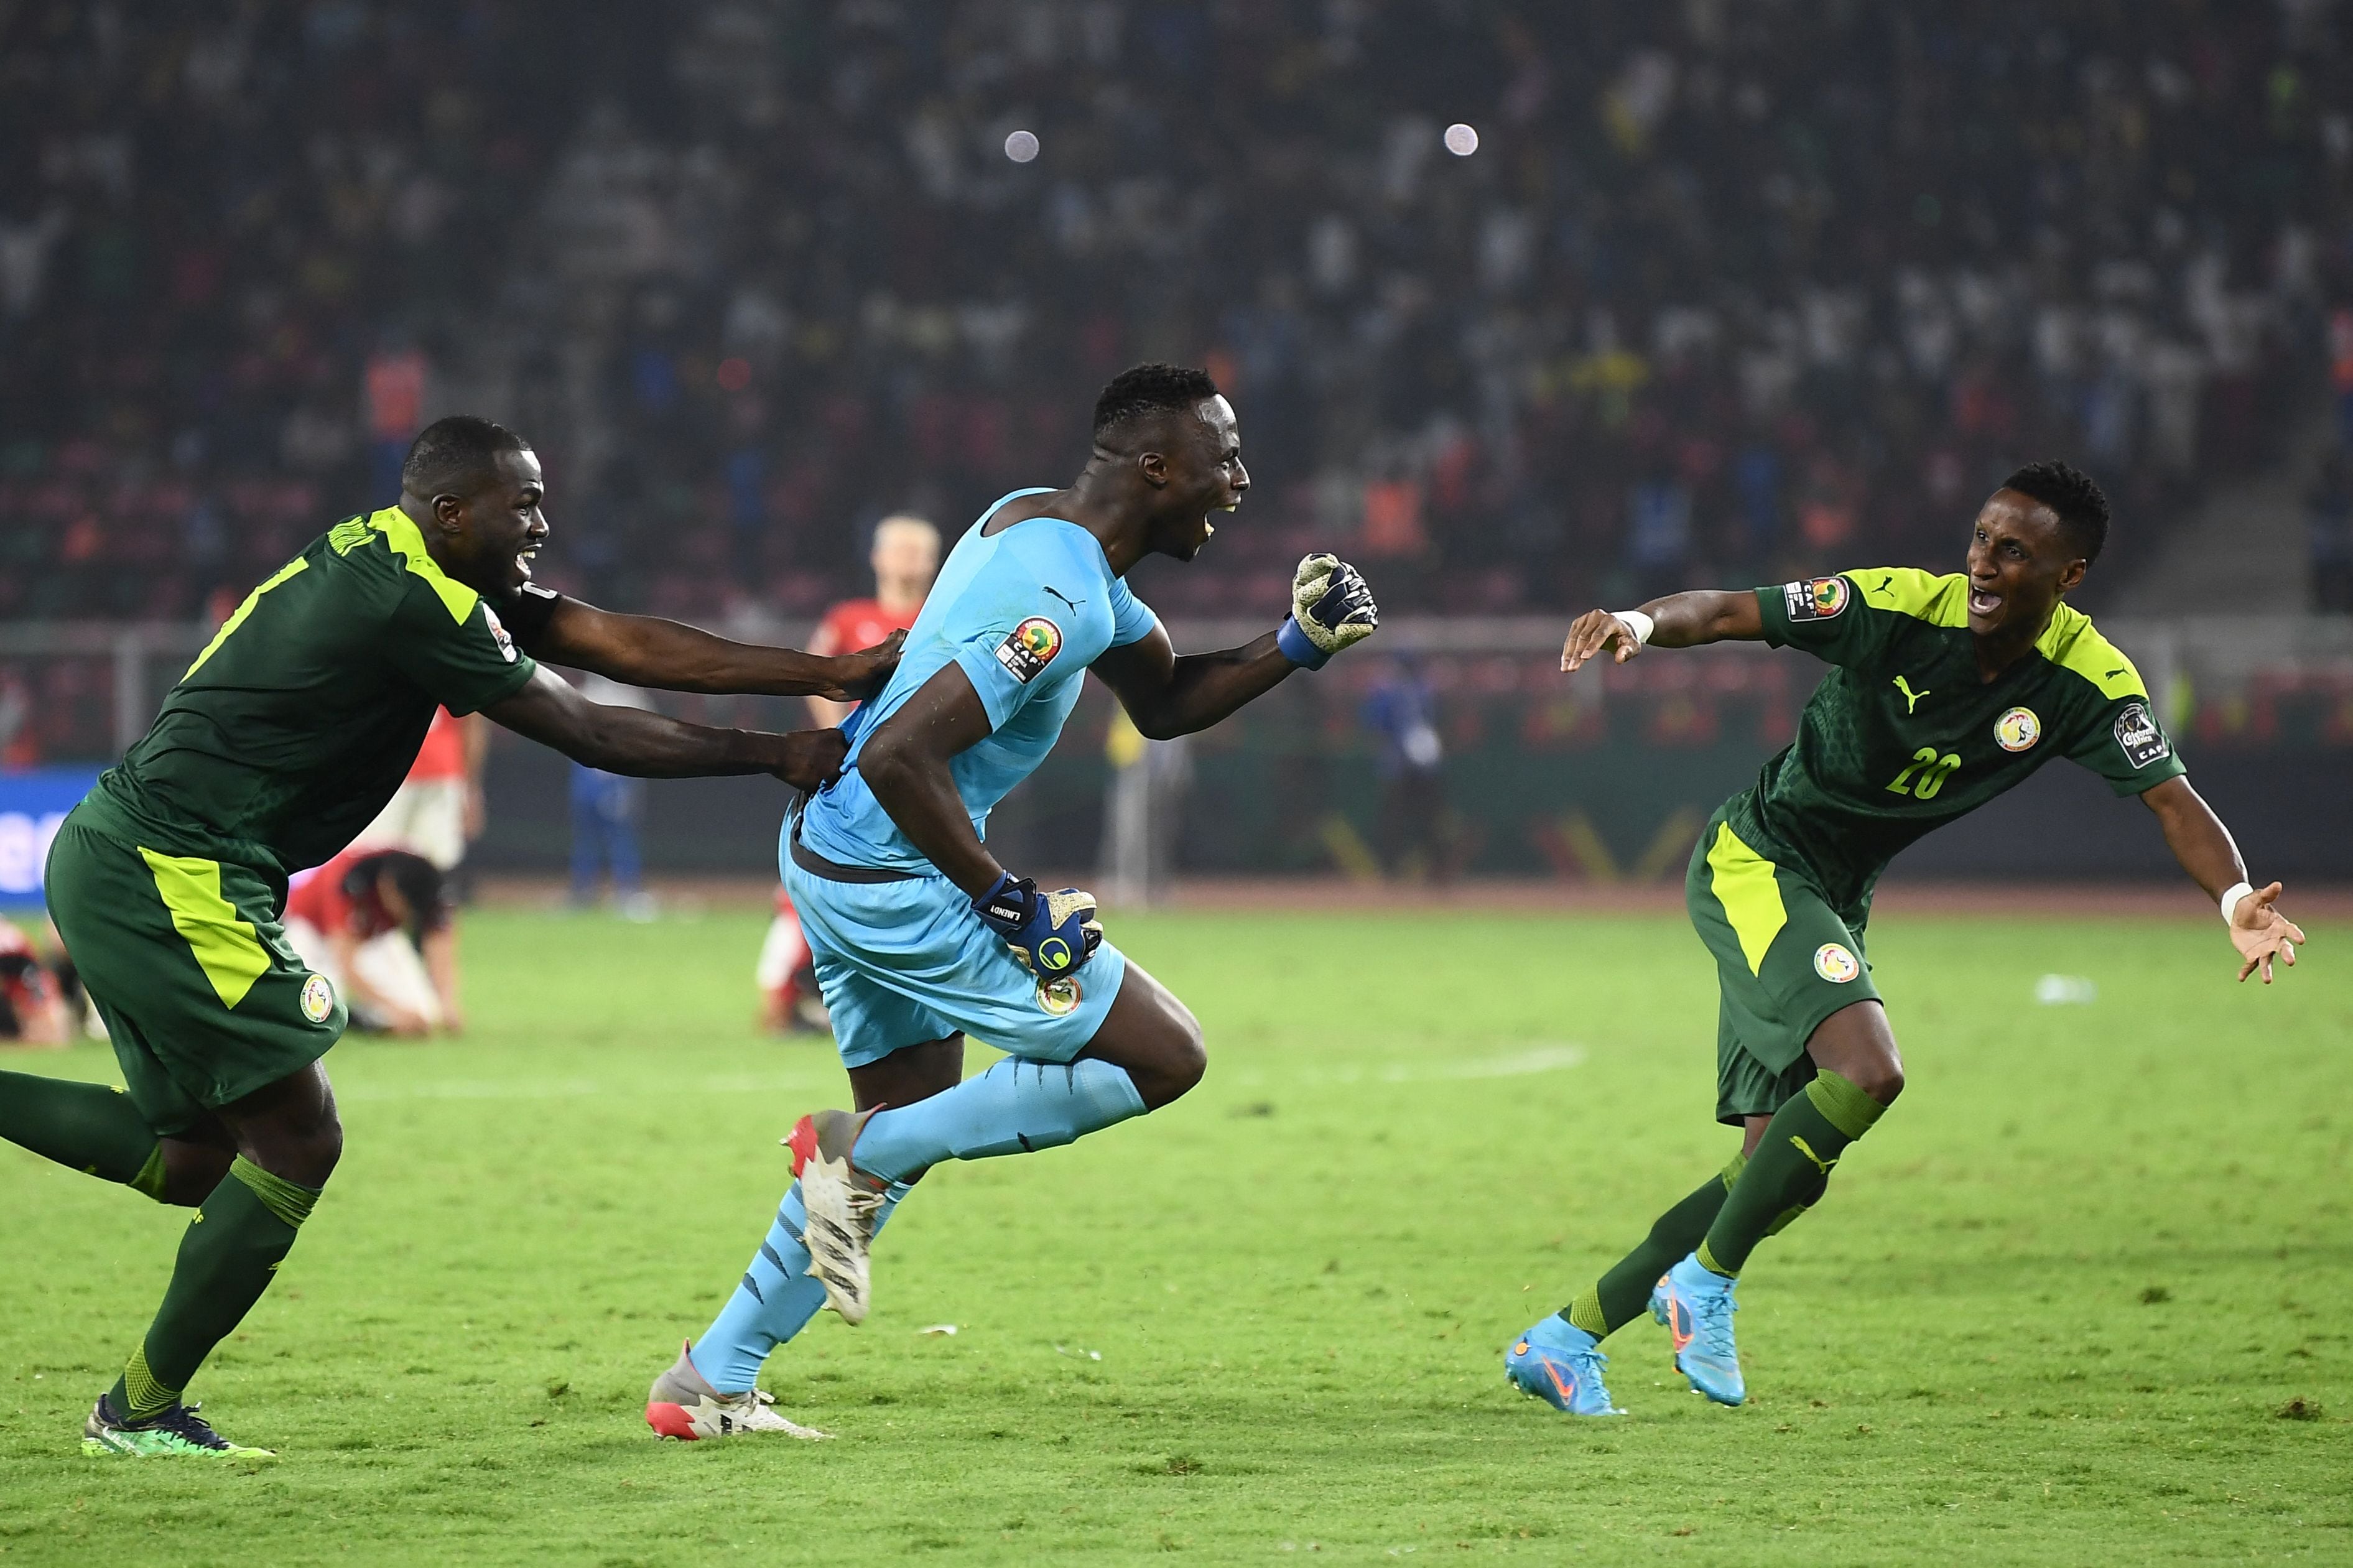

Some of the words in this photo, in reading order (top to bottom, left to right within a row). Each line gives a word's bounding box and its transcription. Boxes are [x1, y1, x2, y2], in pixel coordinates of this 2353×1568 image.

[1804, 585, 1814, 610] CAF
[1014, 642, 1038, 664] CAF
[2138, 745, 2163, 760] CAF
[1884, 746, 1962, 800] 20
